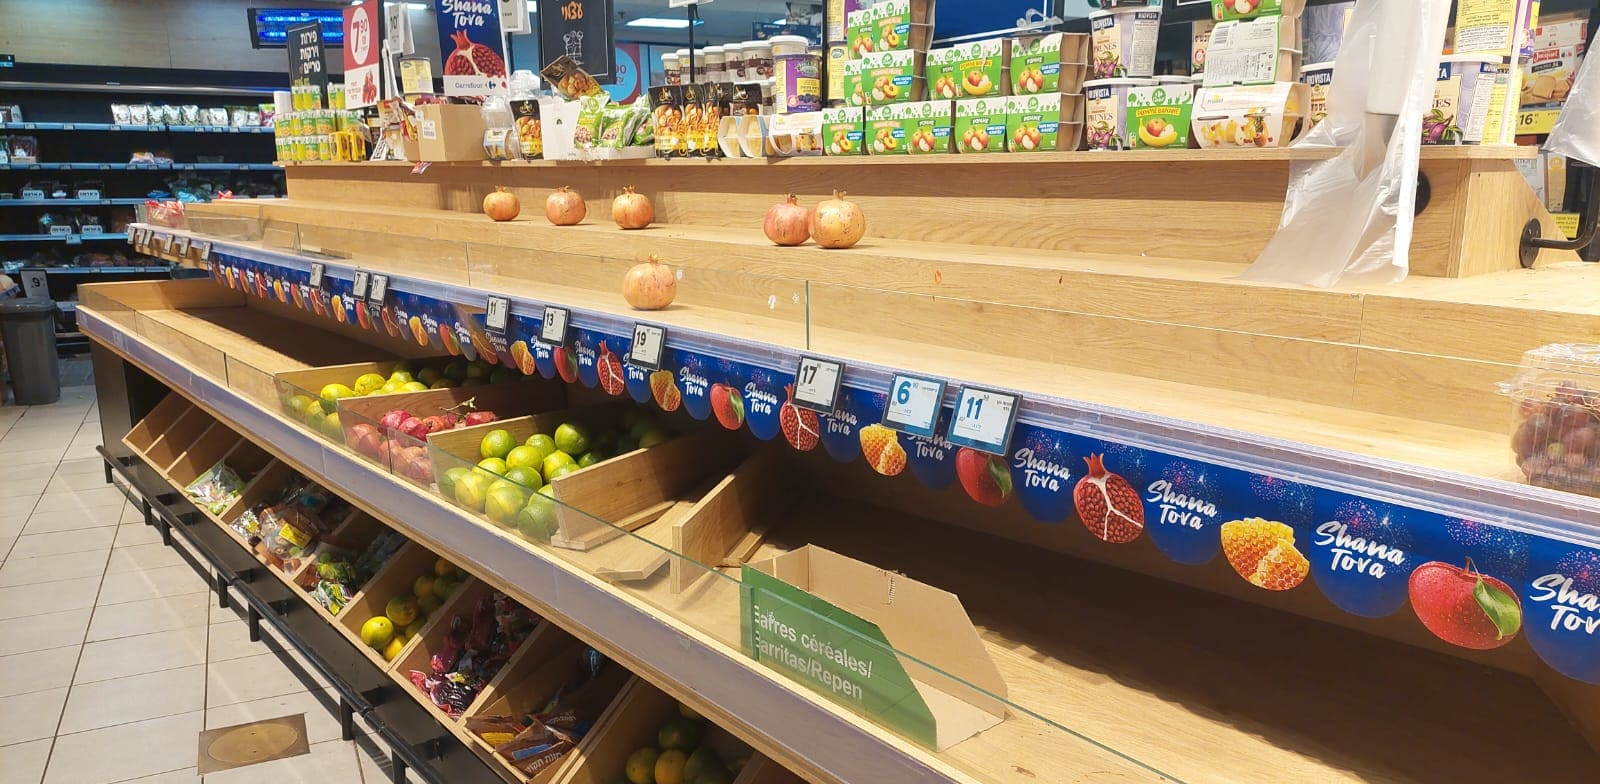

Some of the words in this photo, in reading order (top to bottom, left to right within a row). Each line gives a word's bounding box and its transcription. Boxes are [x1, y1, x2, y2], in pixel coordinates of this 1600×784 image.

[442, 0, 492, 15] Shana
[452, 12, 484, 29] Tova
[300, 30, 318, 45] פירות
[352, 21, 361, 53] 7
[300, 46, 318, 60] וירקות
[304, 62, 321, 74] טריים
[1520, 114, 1533, 126] 16
[490, 302, 497, 316] 11
[546, 313, 554, 326] 13
[636, 331, 647, 346] 19
[536, 348, 550, 360] Tova
[574, 340, 595, 358] Shana
[578, 354, 592, 367] Tova
[628, 367, 644, 381] Tova
[679, 367, 708, 388] Shana
[802, 365, 818, 384] 17
[685, 380, 704, 397] Tova
[744, 382, 778, 406] Shana
[897, 380, 911, 404] 6
[750, 398, 772, 416] Tova
[967, 396, 984, 420] 11
[826, 418, 851, 436] Tova
[916, 441, 945, 462] Tova
[1014, 448, 1071, 480] Shana
[1025, 469, 1060, 492] Tova
[1146, 479, 1218, 518] Shana
[1159, 506, 1203, 531] Tova
[1314, 520, 1405, 565] Shana
[1330, 548, 1386, 579] Tova
[801, 633, 873, 679] céréales/
